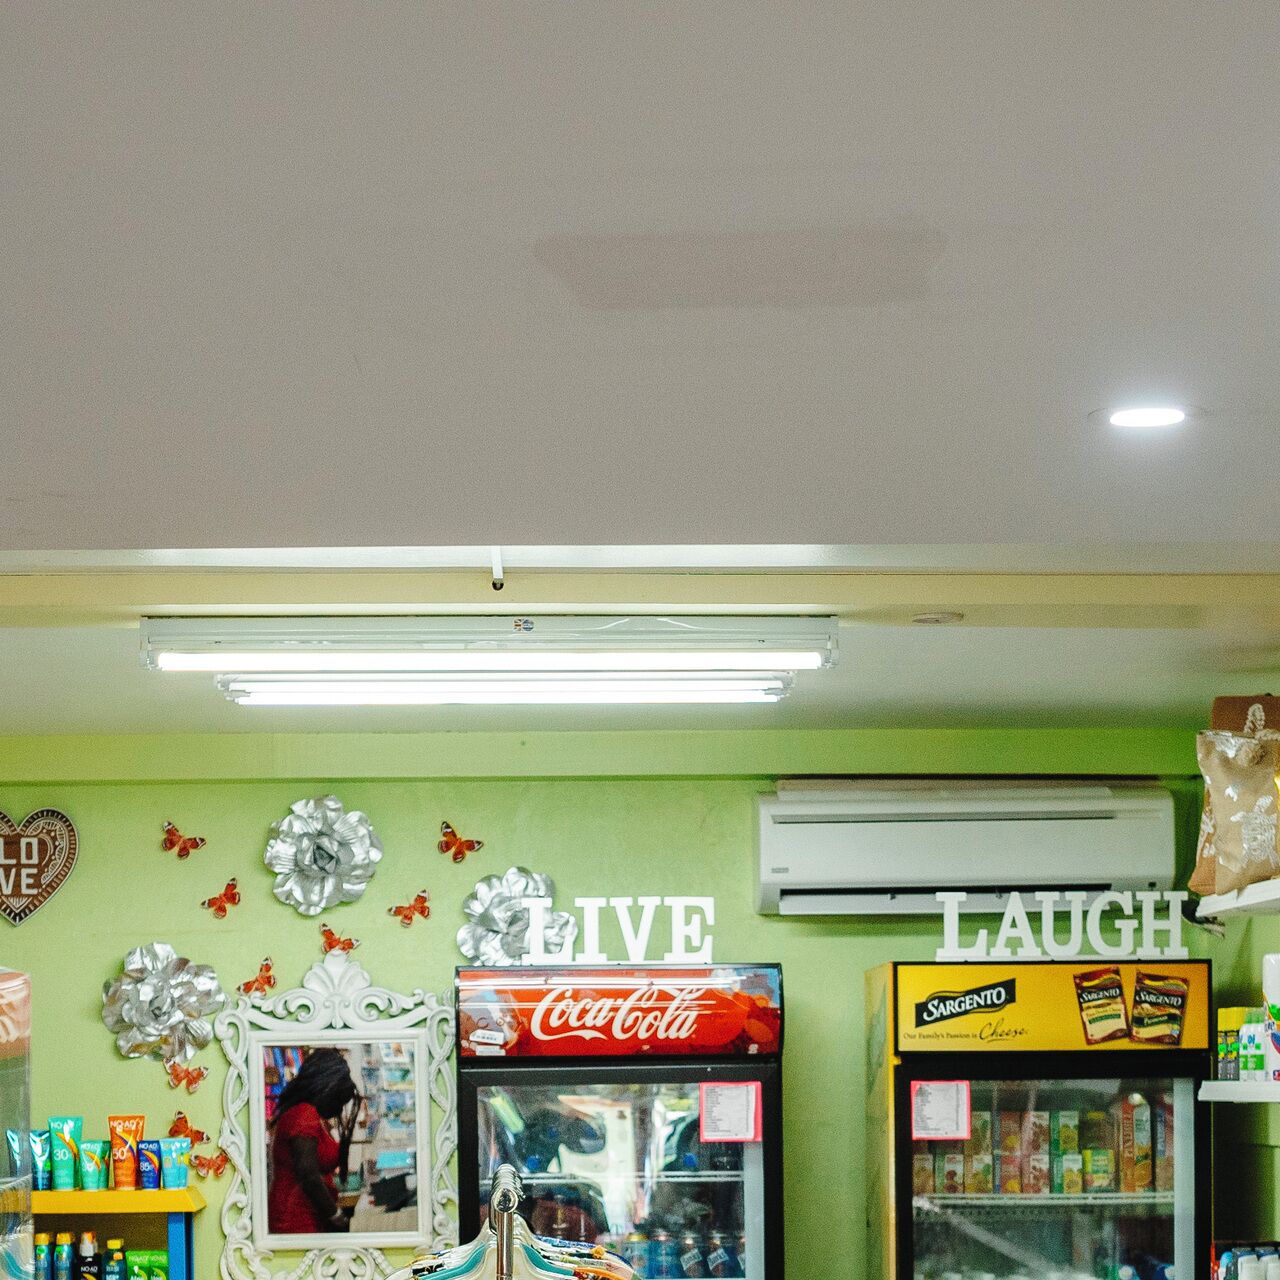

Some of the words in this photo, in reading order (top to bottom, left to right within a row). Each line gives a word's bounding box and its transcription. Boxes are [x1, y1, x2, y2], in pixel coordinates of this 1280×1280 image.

[521, 896, 715, 964] LIVE
[935, 891, 1189, 960] LAUGH
[922, 986, 1007, 1022] SARGENTO
[1080, 987, 1120, 1003] SARGENTO
[1135, 990, 1182, 1007] SARGENTO
